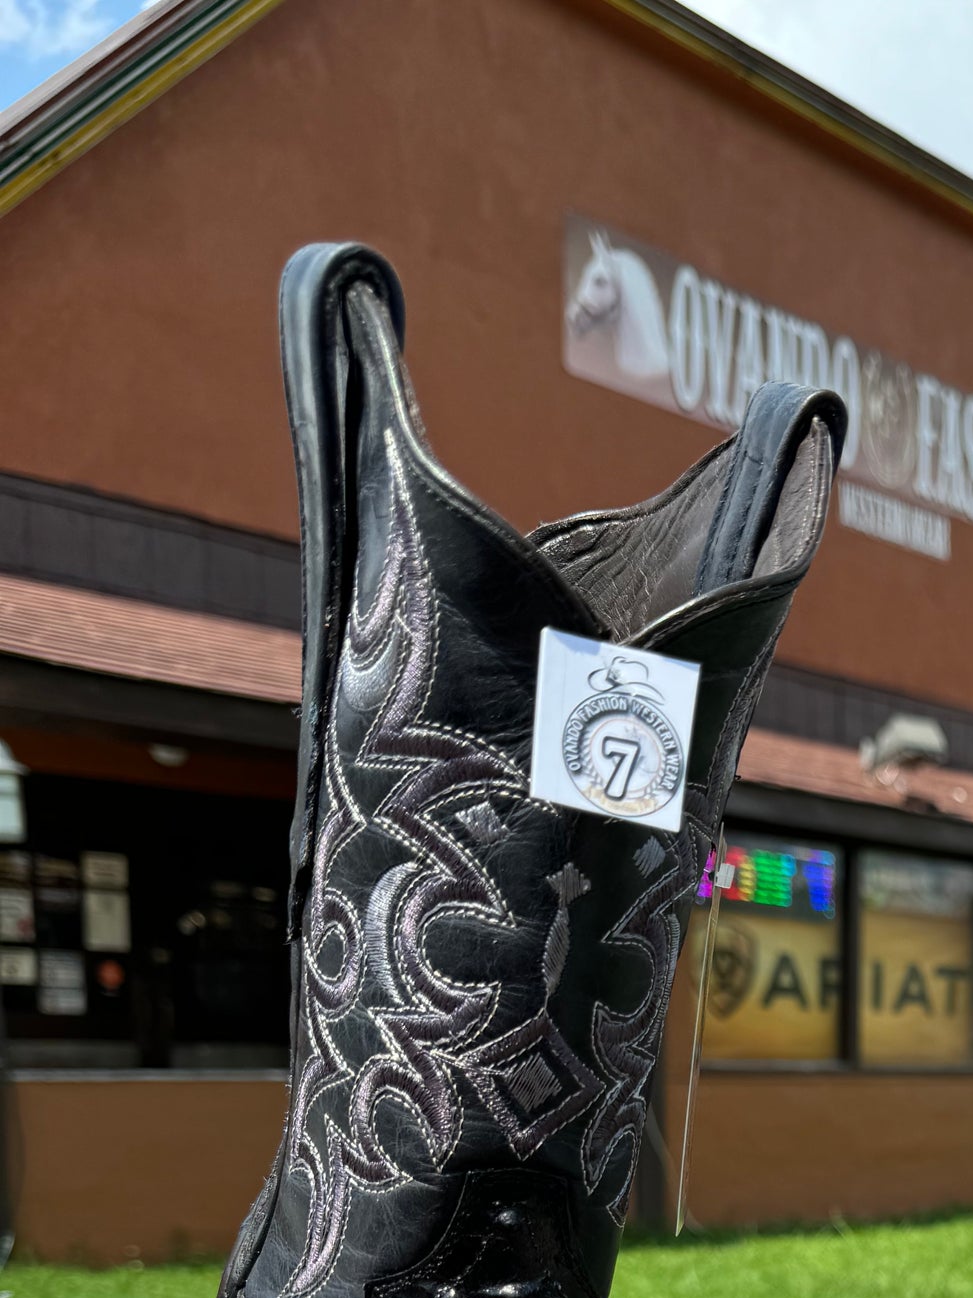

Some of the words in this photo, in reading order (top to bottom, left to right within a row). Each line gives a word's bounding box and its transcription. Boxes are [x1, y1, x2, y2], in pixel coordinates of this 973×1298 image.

[669, 264, 862, 471] OVANDO
[563, 718, 584, 772] OVANDO
[580, 695, 628, 724] FASHION
[631, 700, 677, 750] WESTERN
[660, 750, 681, 791] WEAR
[601, 736, 641, 801] 7
